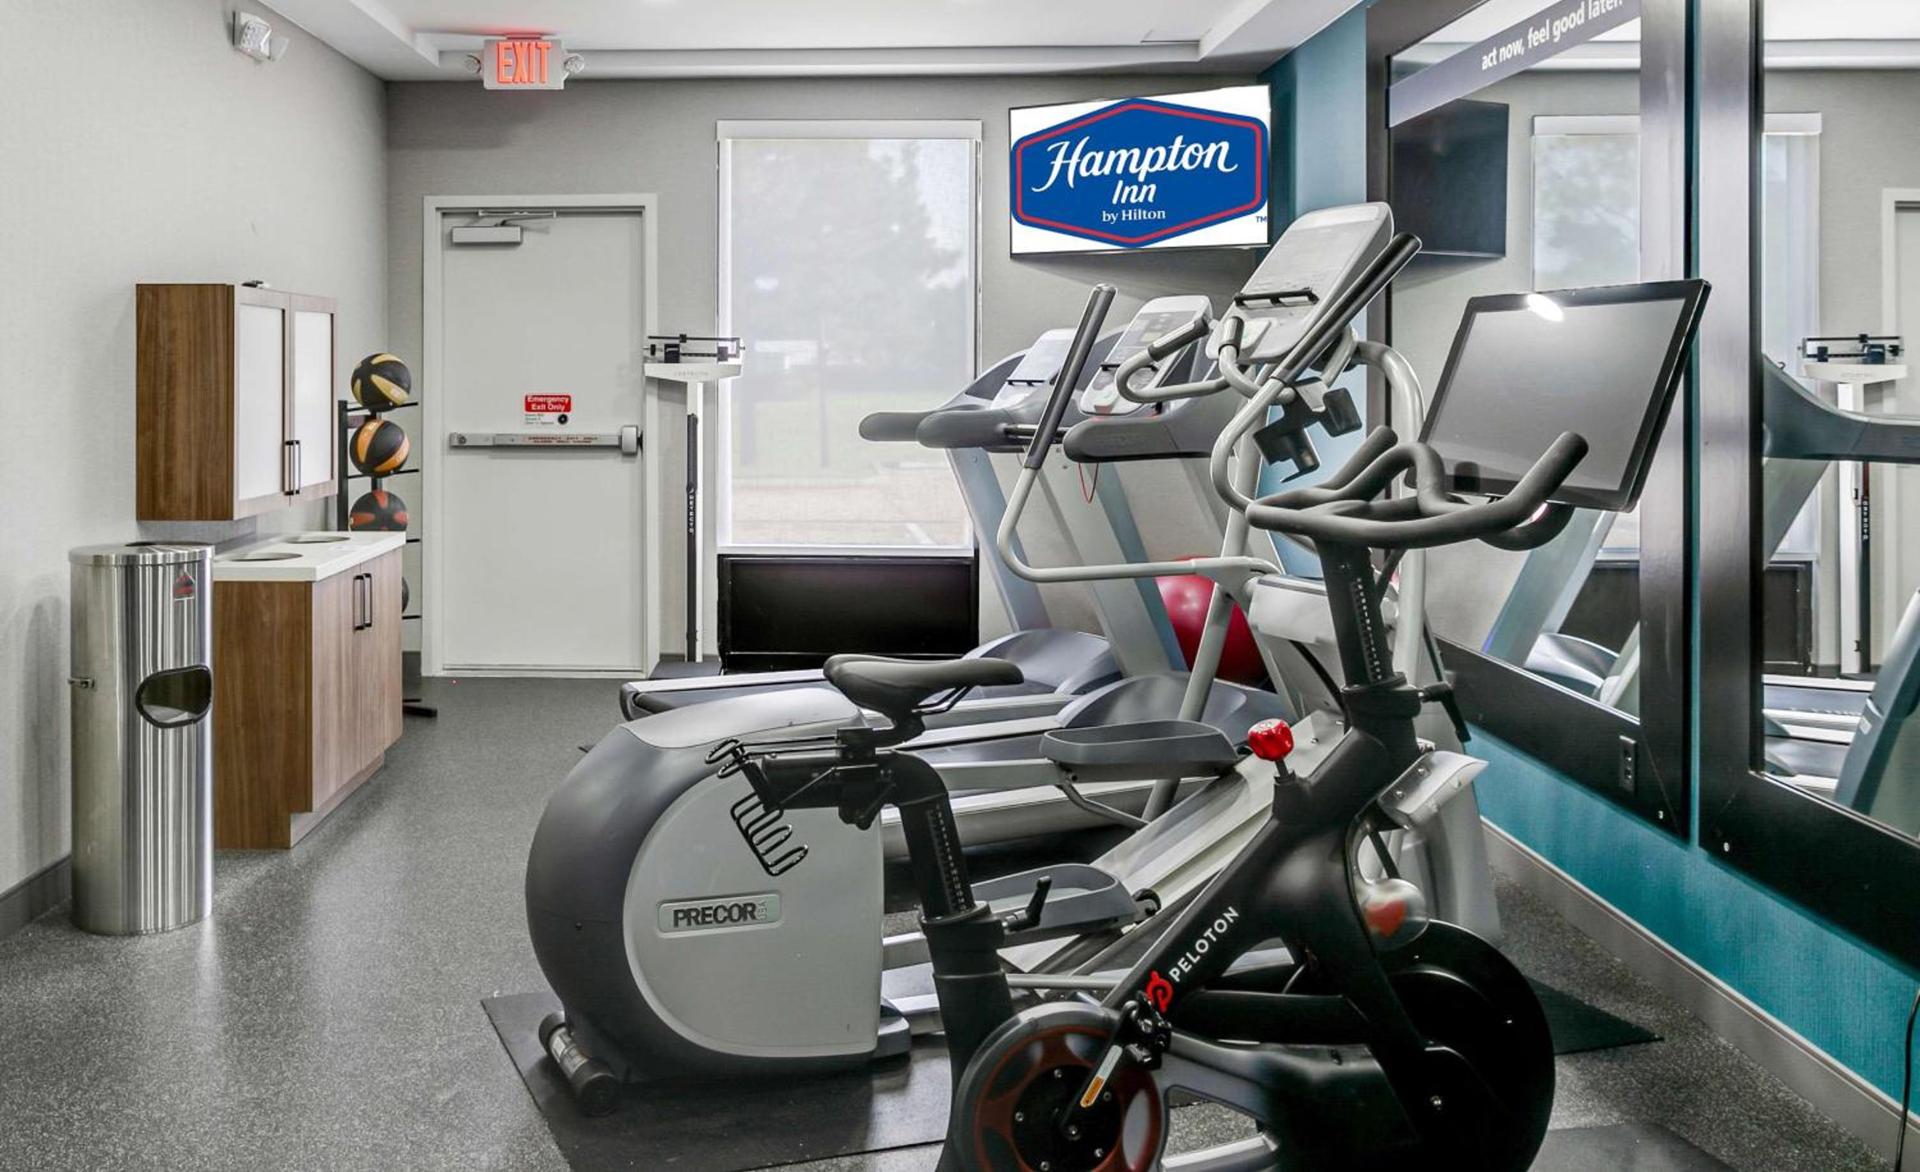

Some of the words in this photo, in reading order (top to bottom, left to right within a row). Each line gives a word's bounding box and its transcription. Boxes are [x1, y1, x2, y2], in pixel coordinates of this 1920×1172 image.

[1481, 48, 1498, 70] act
[1499, 37, 1525, 63] now,
[1527, 19, 1550, 49] feel
[1552, 2, 1585, 42] good
[496, 41, 552, 84] EXIT
[1031, 134, 1239, 193] Hampton
[1111, 179, 1157, 205] Inn
[1102, 210, 1119, 225] by
[1121, 208, 1166, 221] Hilton
[527, 396, 570, 405] Emergency
[531, 403, 547, 411] Exit
[547, 403, 566, 412] Only
[672, 902, 757, 928] PRECOR
[1168, 906, 1239, 982] PELOTON
